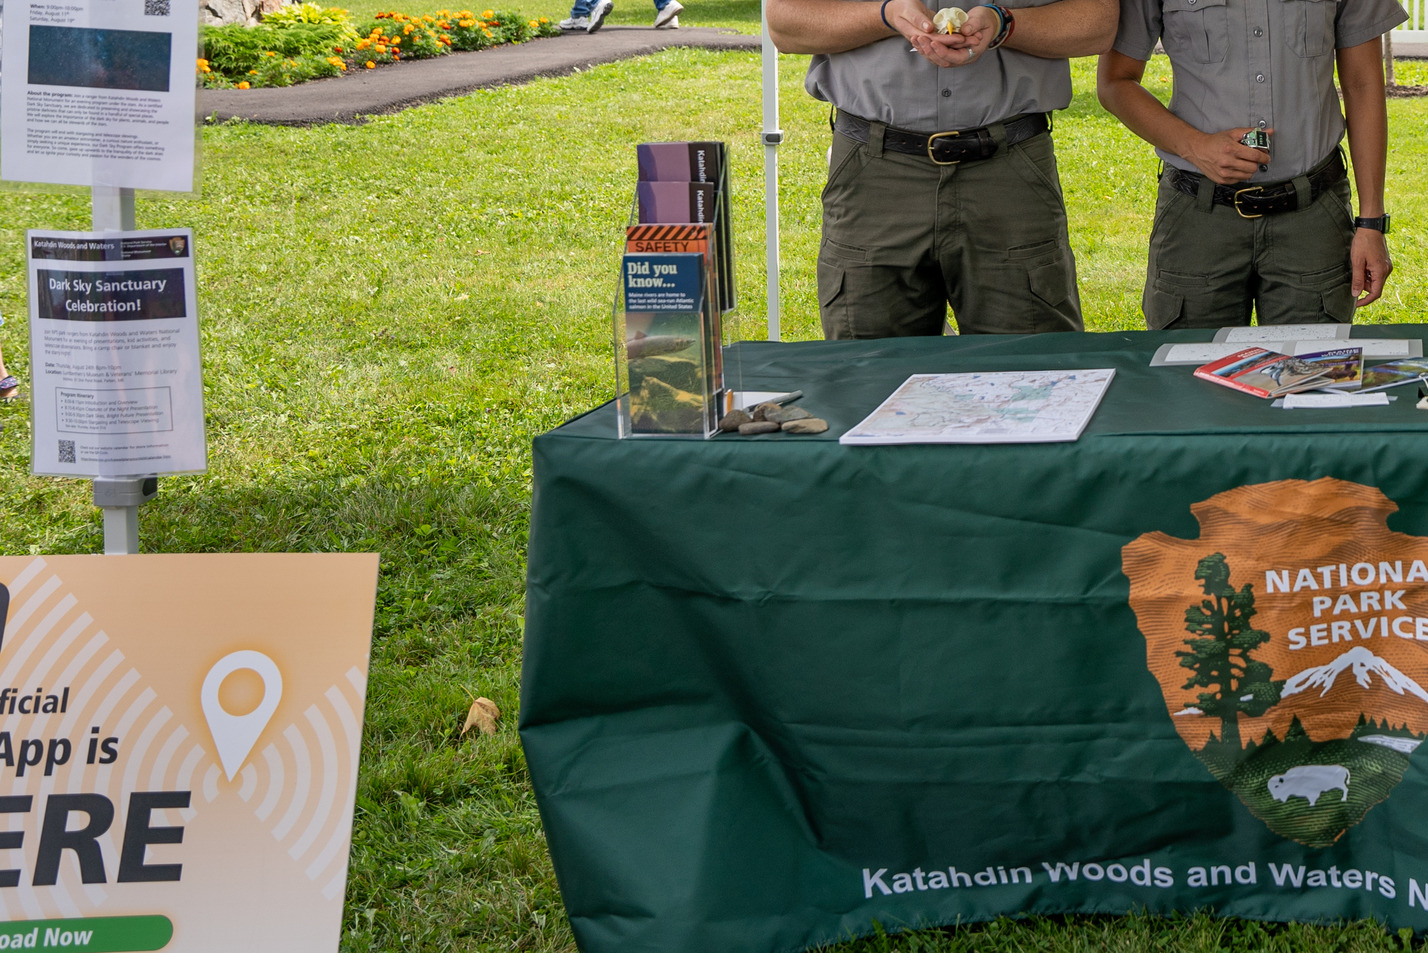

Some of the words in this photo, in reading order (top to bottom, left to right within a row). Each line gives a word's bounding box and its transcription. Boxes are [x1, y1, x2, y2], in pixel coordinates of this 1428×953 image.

[34, 240, 56, 249] Katahdin
[78, 242, 87, 250] and
[89, 242, 115, 250] Waters
[635, 242, 689, 252] SAFETY
[627, 262, 650, 274] Did
[653, 265, 677, 277] you
[49, 278, 71, 290] Dark
[73, 279, 92, 292] Sky
[96, 279, 167, 292] Sanctuary
[628, 275, 675, 288] know...
[65, 299, 141, 313] Celebration!
[1312, 590, 1406, 617] PARK
[0, 731, 71, 777] App
[87, 727, 118, 764] is
[0, 791, 191, 887] ERE
[863, 866, 1032, 898] Katahdin
[1043, 859, 1174, 888] Woods
[1187, 862, 1256, 886] and
[1267, 863, 1396, 899] Waters
[43, 928, 93, 947] Now
